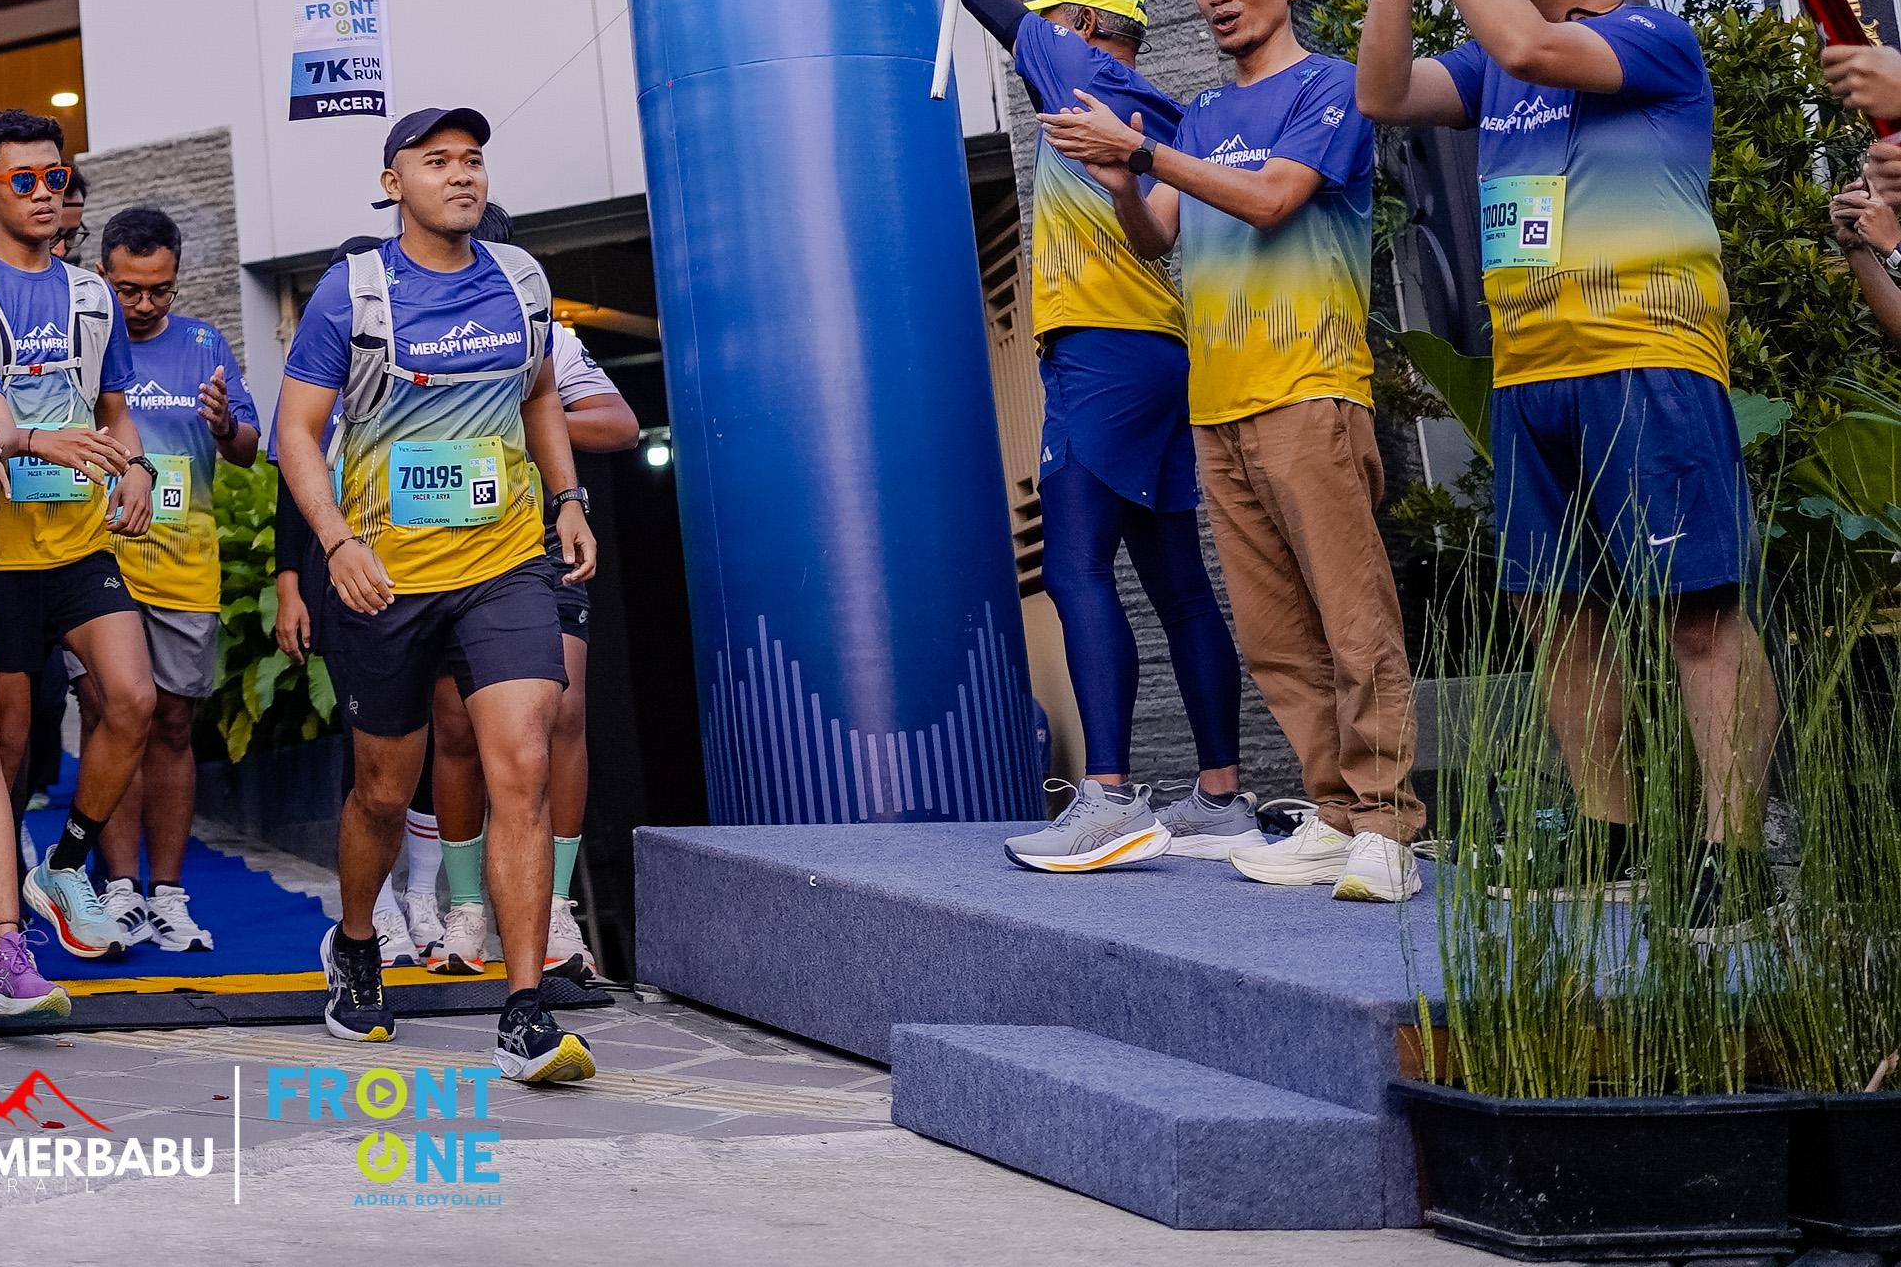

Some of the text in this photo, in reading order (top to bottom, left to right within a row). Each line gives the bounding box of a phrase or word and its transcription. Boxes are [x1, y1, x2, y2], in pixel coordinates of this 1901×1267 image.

[335, 17, 378, 35] ONE
[304, 58, 354, 85] 7K
[352, 57, 381, 69] FUN
[353, 69, 382, 81] RUN
[316, 96, 384, 113] PACER 7
[1224, 148, 1271, 165] MERBABU
[15, 338, 41, 351] RAPI
[410, 330, 522, 356] MERAPI MERBABU
[140, 395, 196, 408] MERBABU
[398, 465, 463, 490] 70195
[412, 493, 431, 501] PACER
